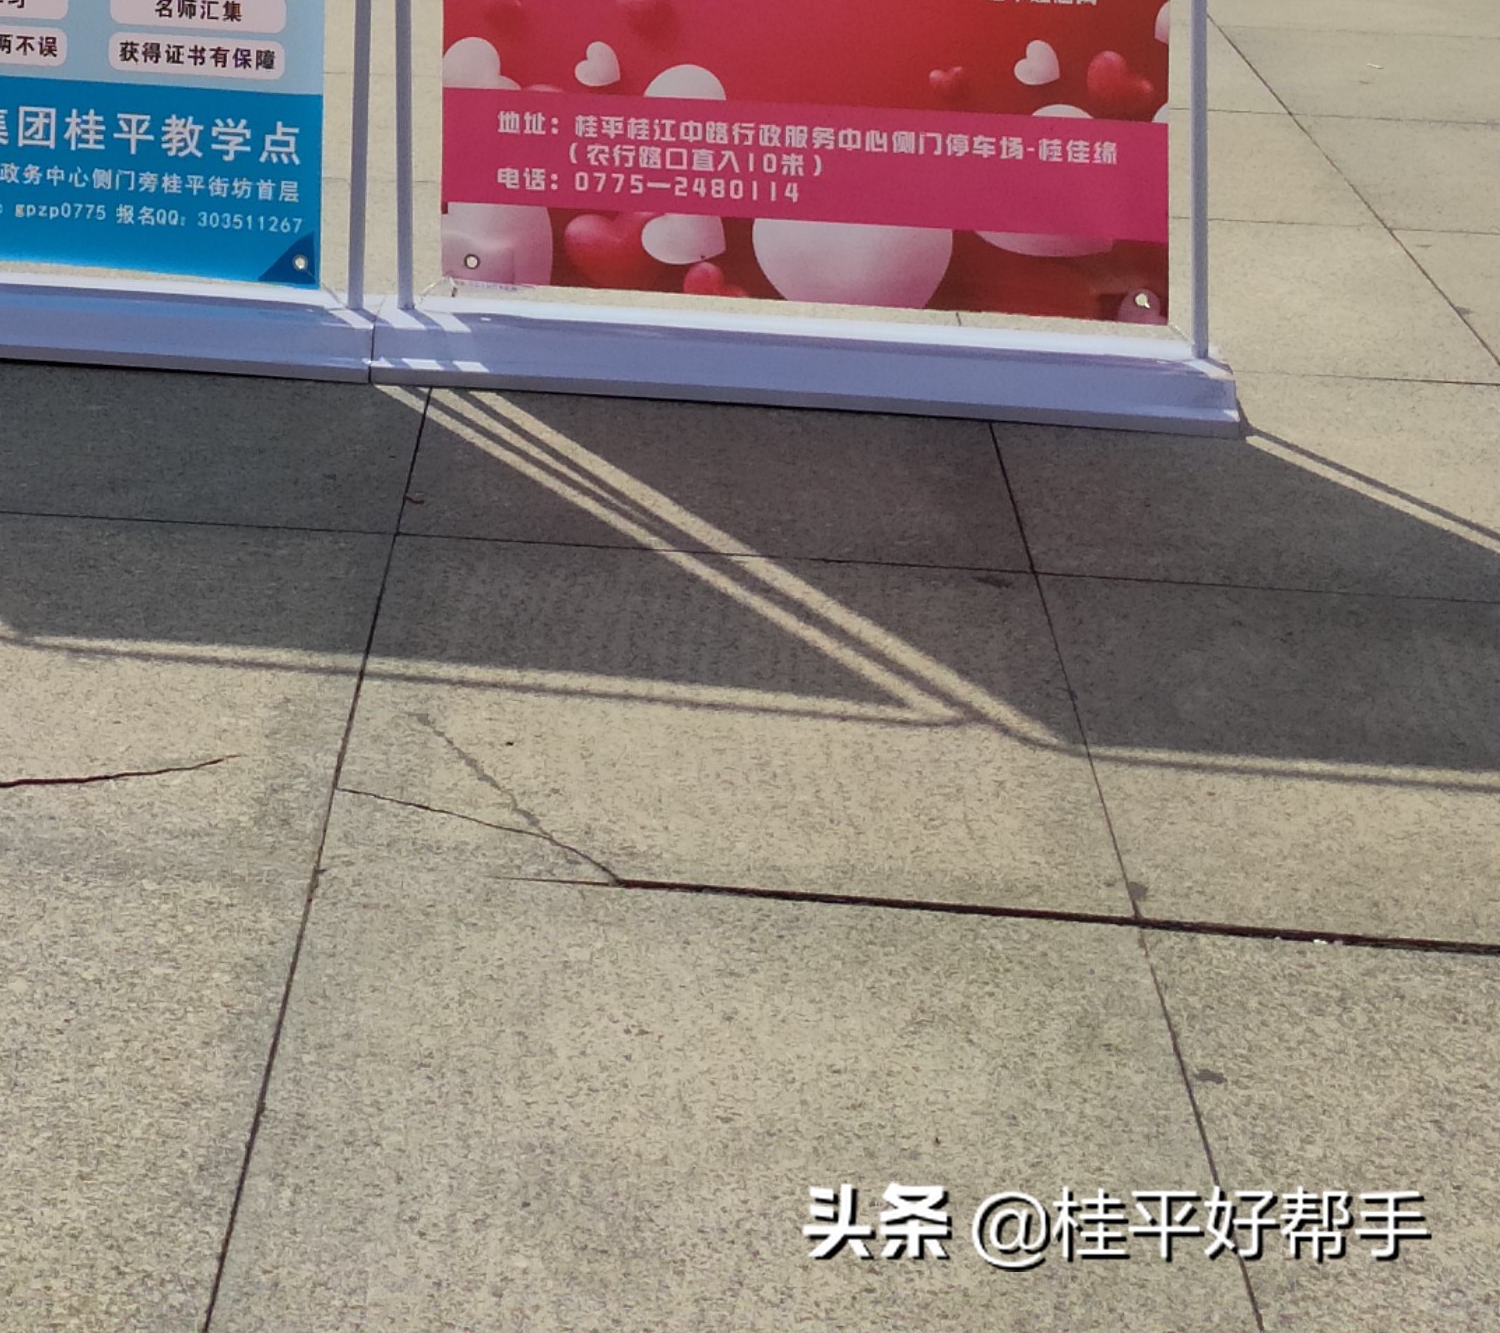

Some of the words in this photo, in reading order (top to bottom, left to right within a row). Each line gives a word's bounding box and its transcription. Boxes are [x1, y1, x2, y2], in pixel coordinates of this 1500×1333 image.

[118, 40, 277, 73] 获得证书有保障
